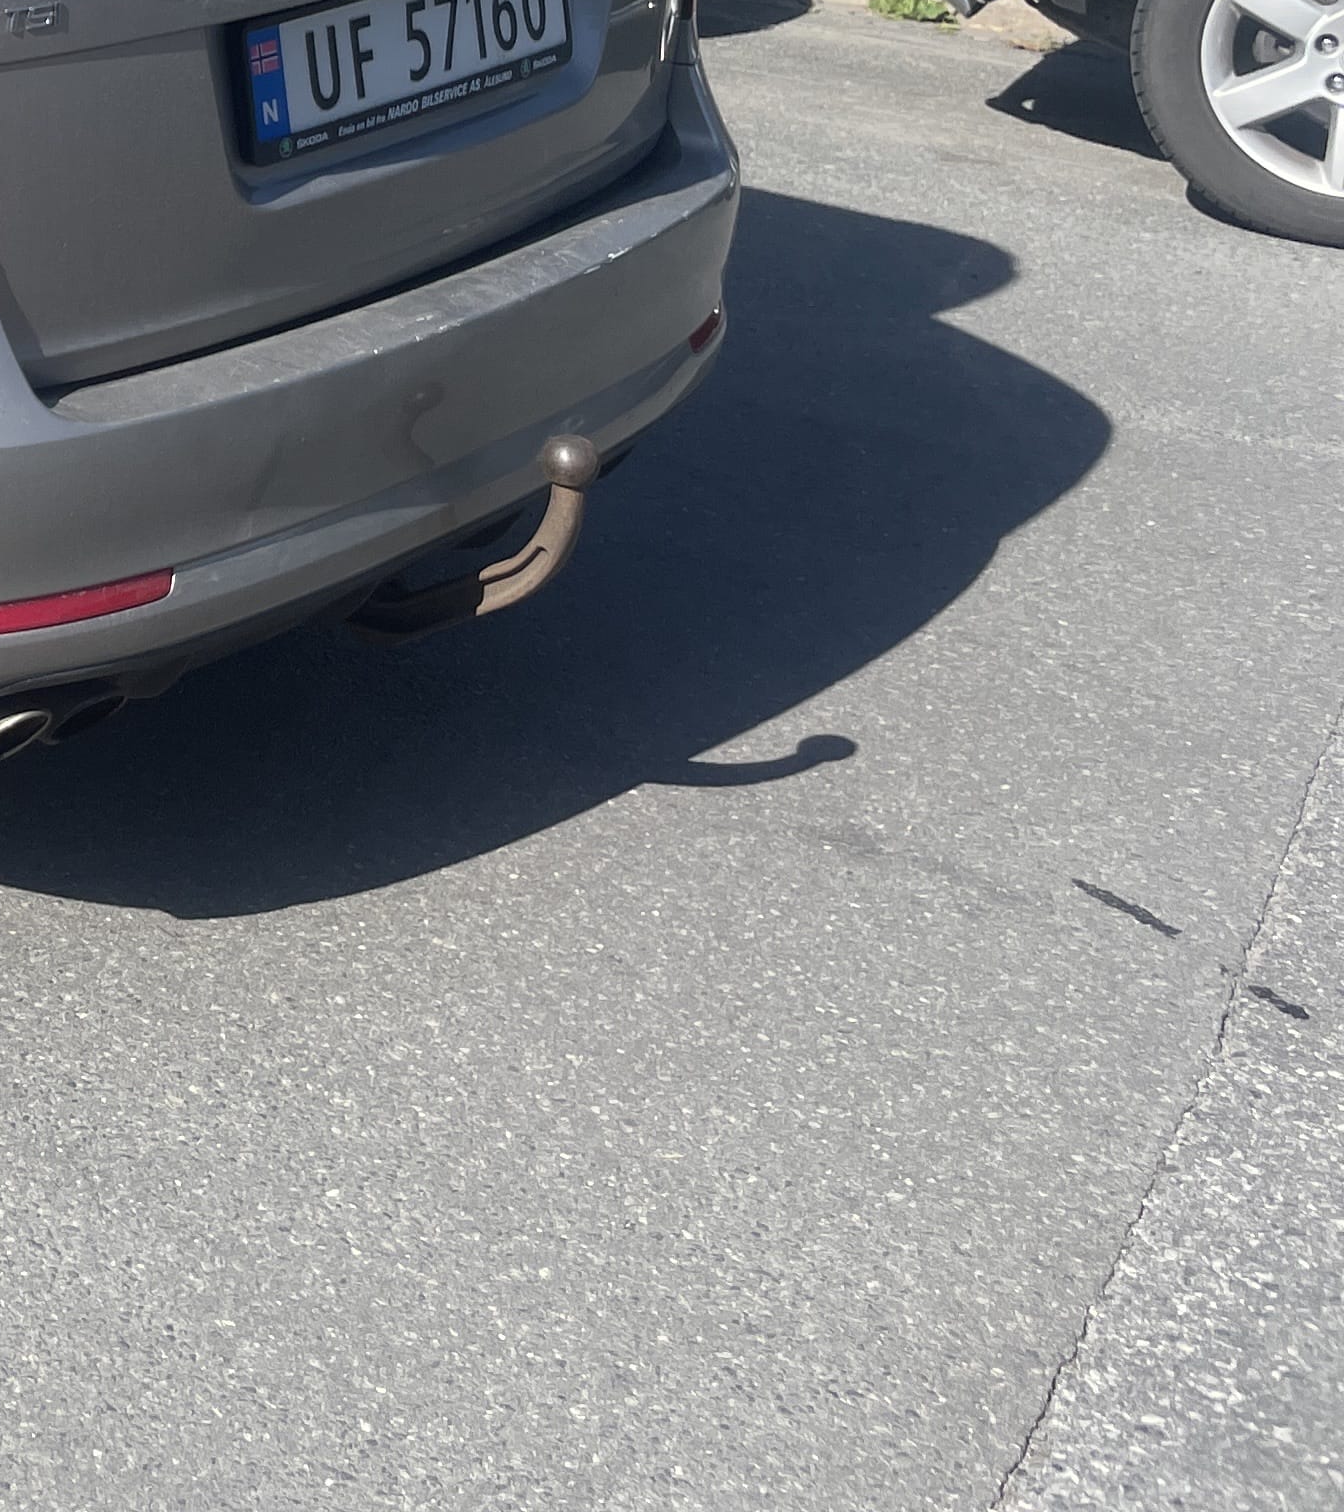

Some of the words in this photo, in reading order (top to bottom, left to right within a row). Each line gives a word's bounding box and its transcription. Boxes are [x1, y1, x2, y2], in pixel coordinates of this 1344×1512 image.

[305, 14, 374, 111] UF
[262, 98, 279, 125] N
[387, 99, 419, 121] NARDO
[421, 81, 468, 110] BILSERVICE
[469, 78, 481, 94] AS
